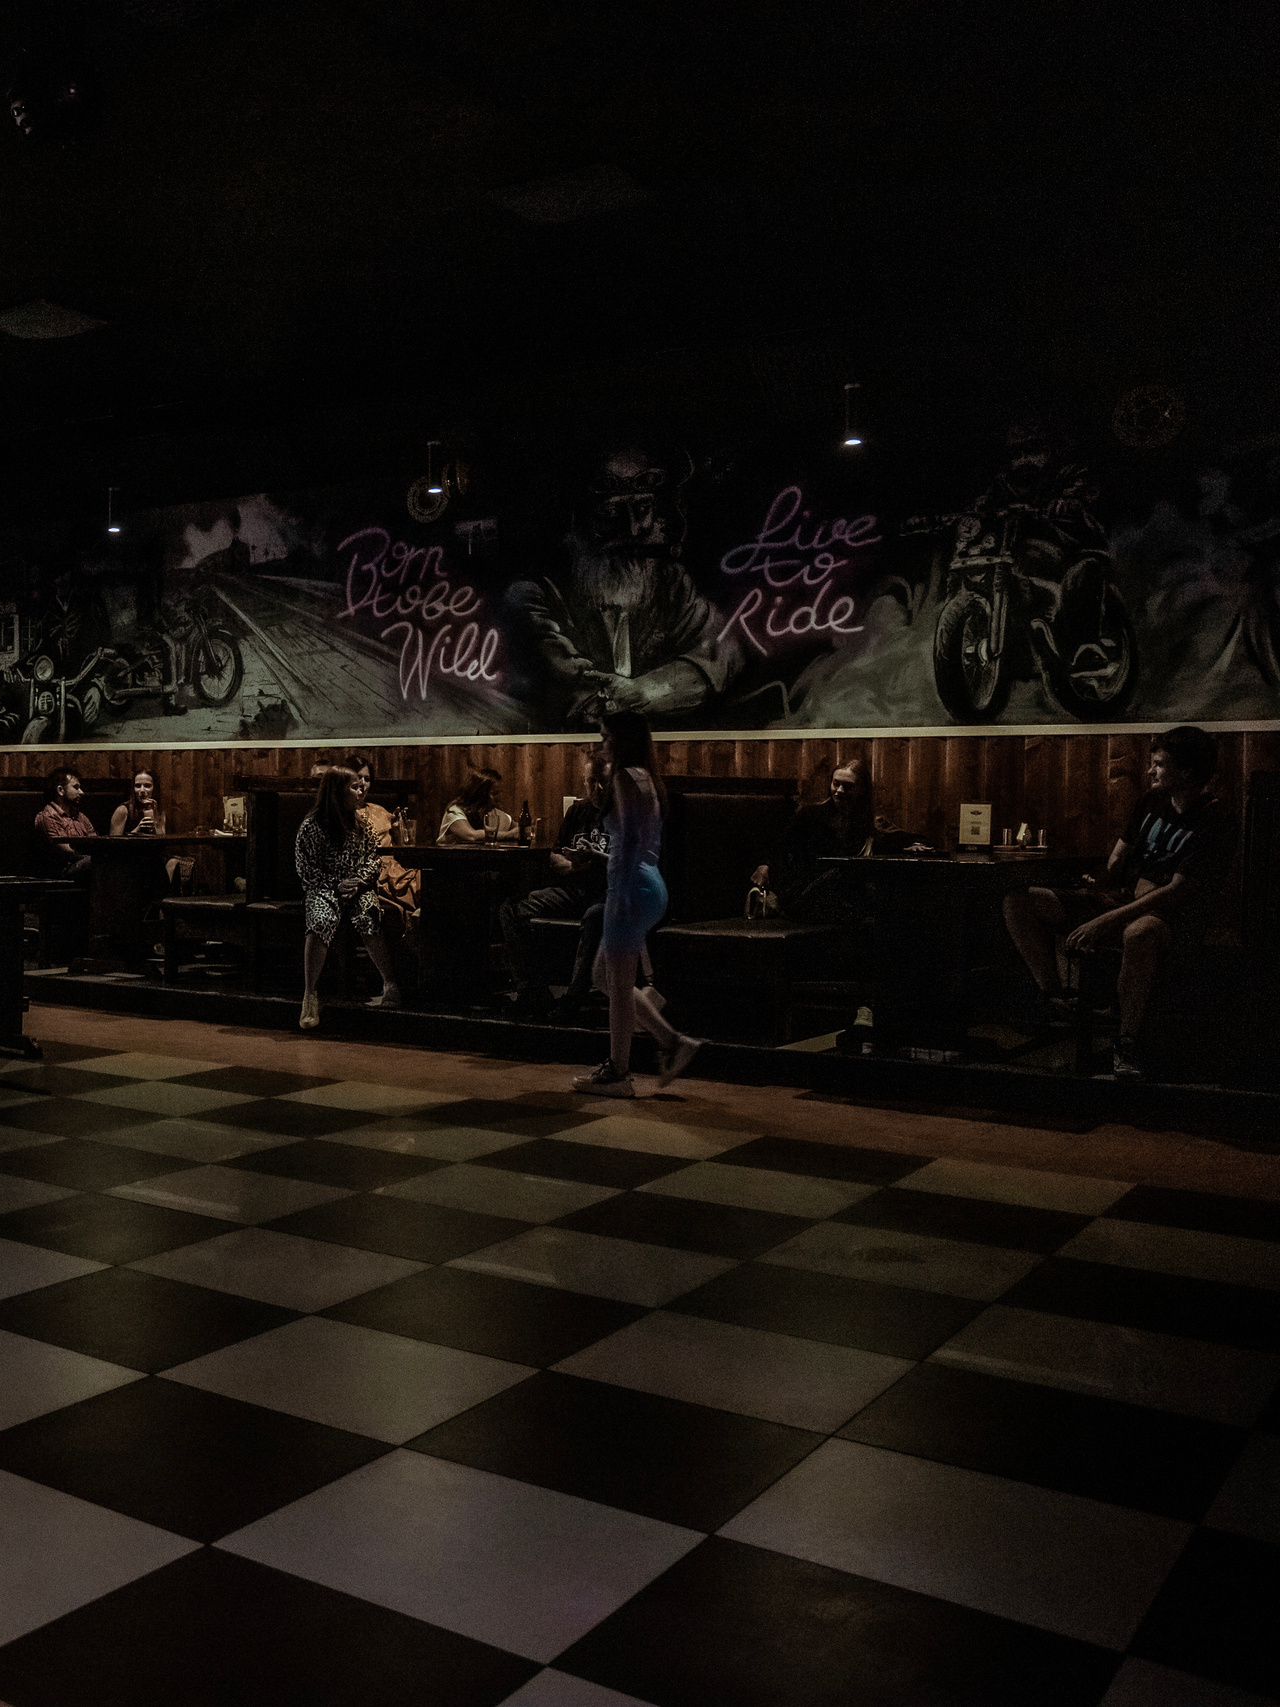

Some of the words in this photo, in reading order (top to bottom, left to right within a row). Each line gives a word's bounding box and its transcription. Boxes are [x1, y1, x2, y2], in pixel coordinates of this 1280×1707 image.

[720, 485, 883, 574] Live
[337, 527, 448, 618] Born
[749, 552, 850, 588] to
[716, 579, 865, 657] Ride
[381, 621, 498, 700] Wild
